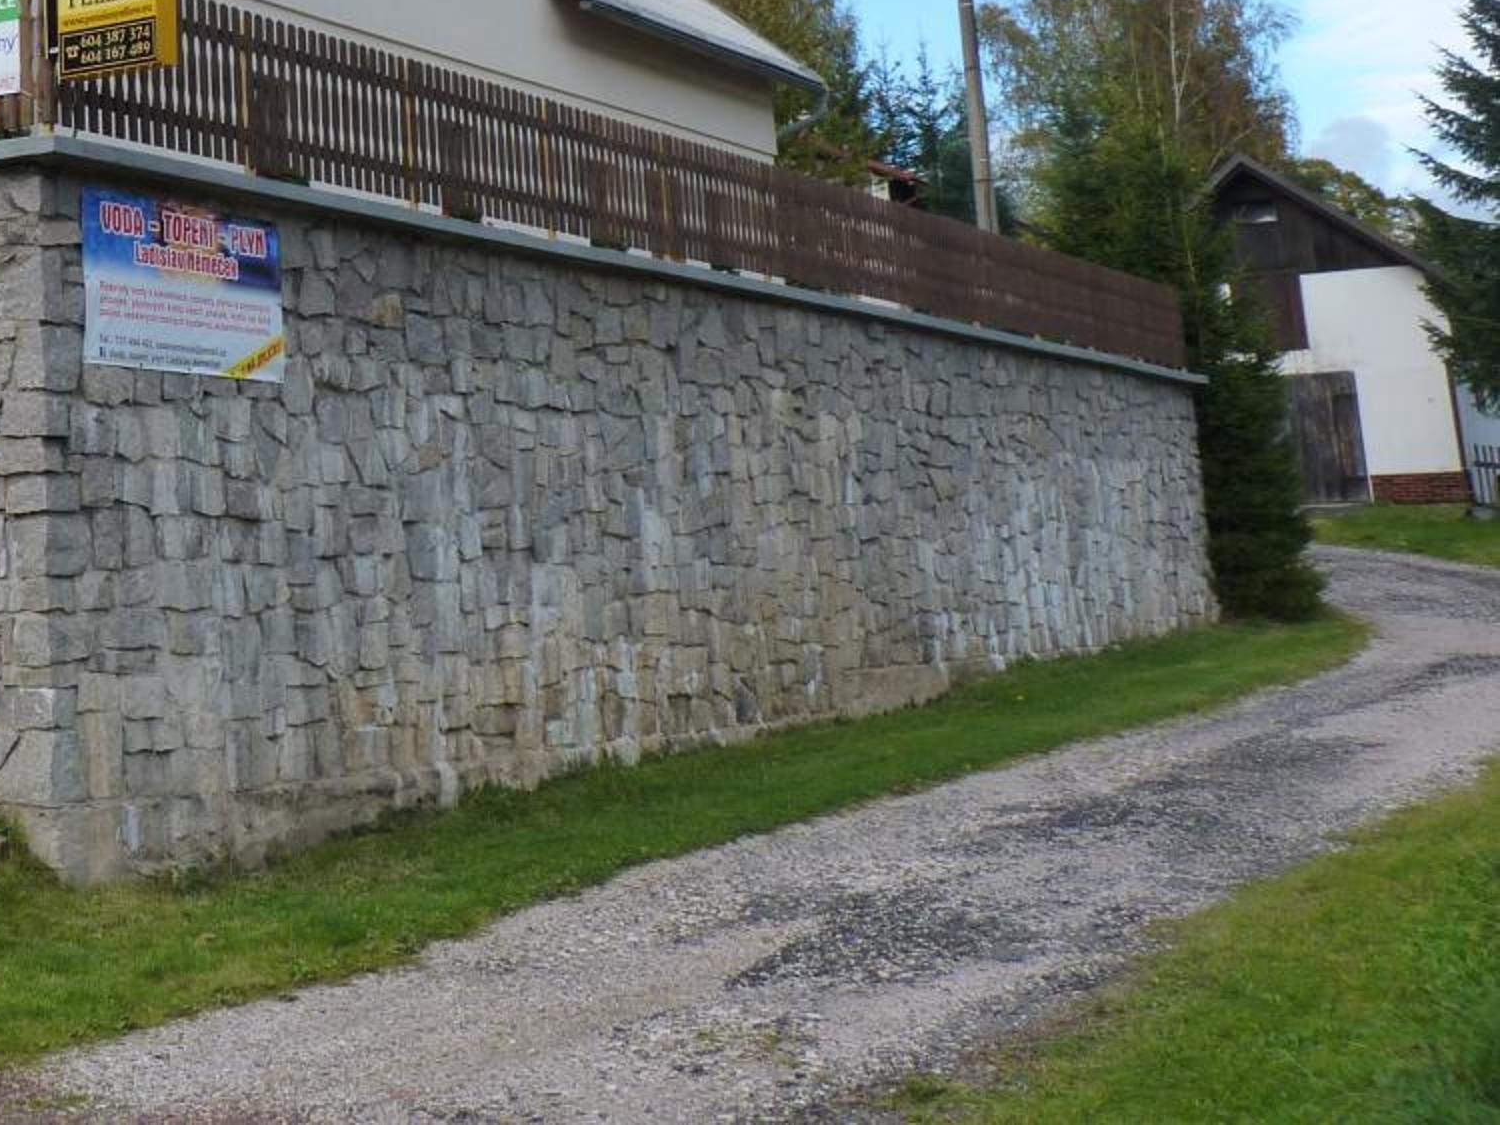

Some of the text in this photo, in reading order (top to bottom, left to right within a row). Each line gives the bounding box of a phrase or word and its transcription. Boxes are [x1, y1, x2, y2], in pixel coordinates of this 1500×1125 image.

[81, 24, 150, 49] 604 387 374
[81, 50, 102, 64] 604
[106, 45, 126, 60] 167
[100, 202, 145, 237] VODA
[229, 225, 266, 259] PLYN
[134, 242, 187, 271] Ladislav
